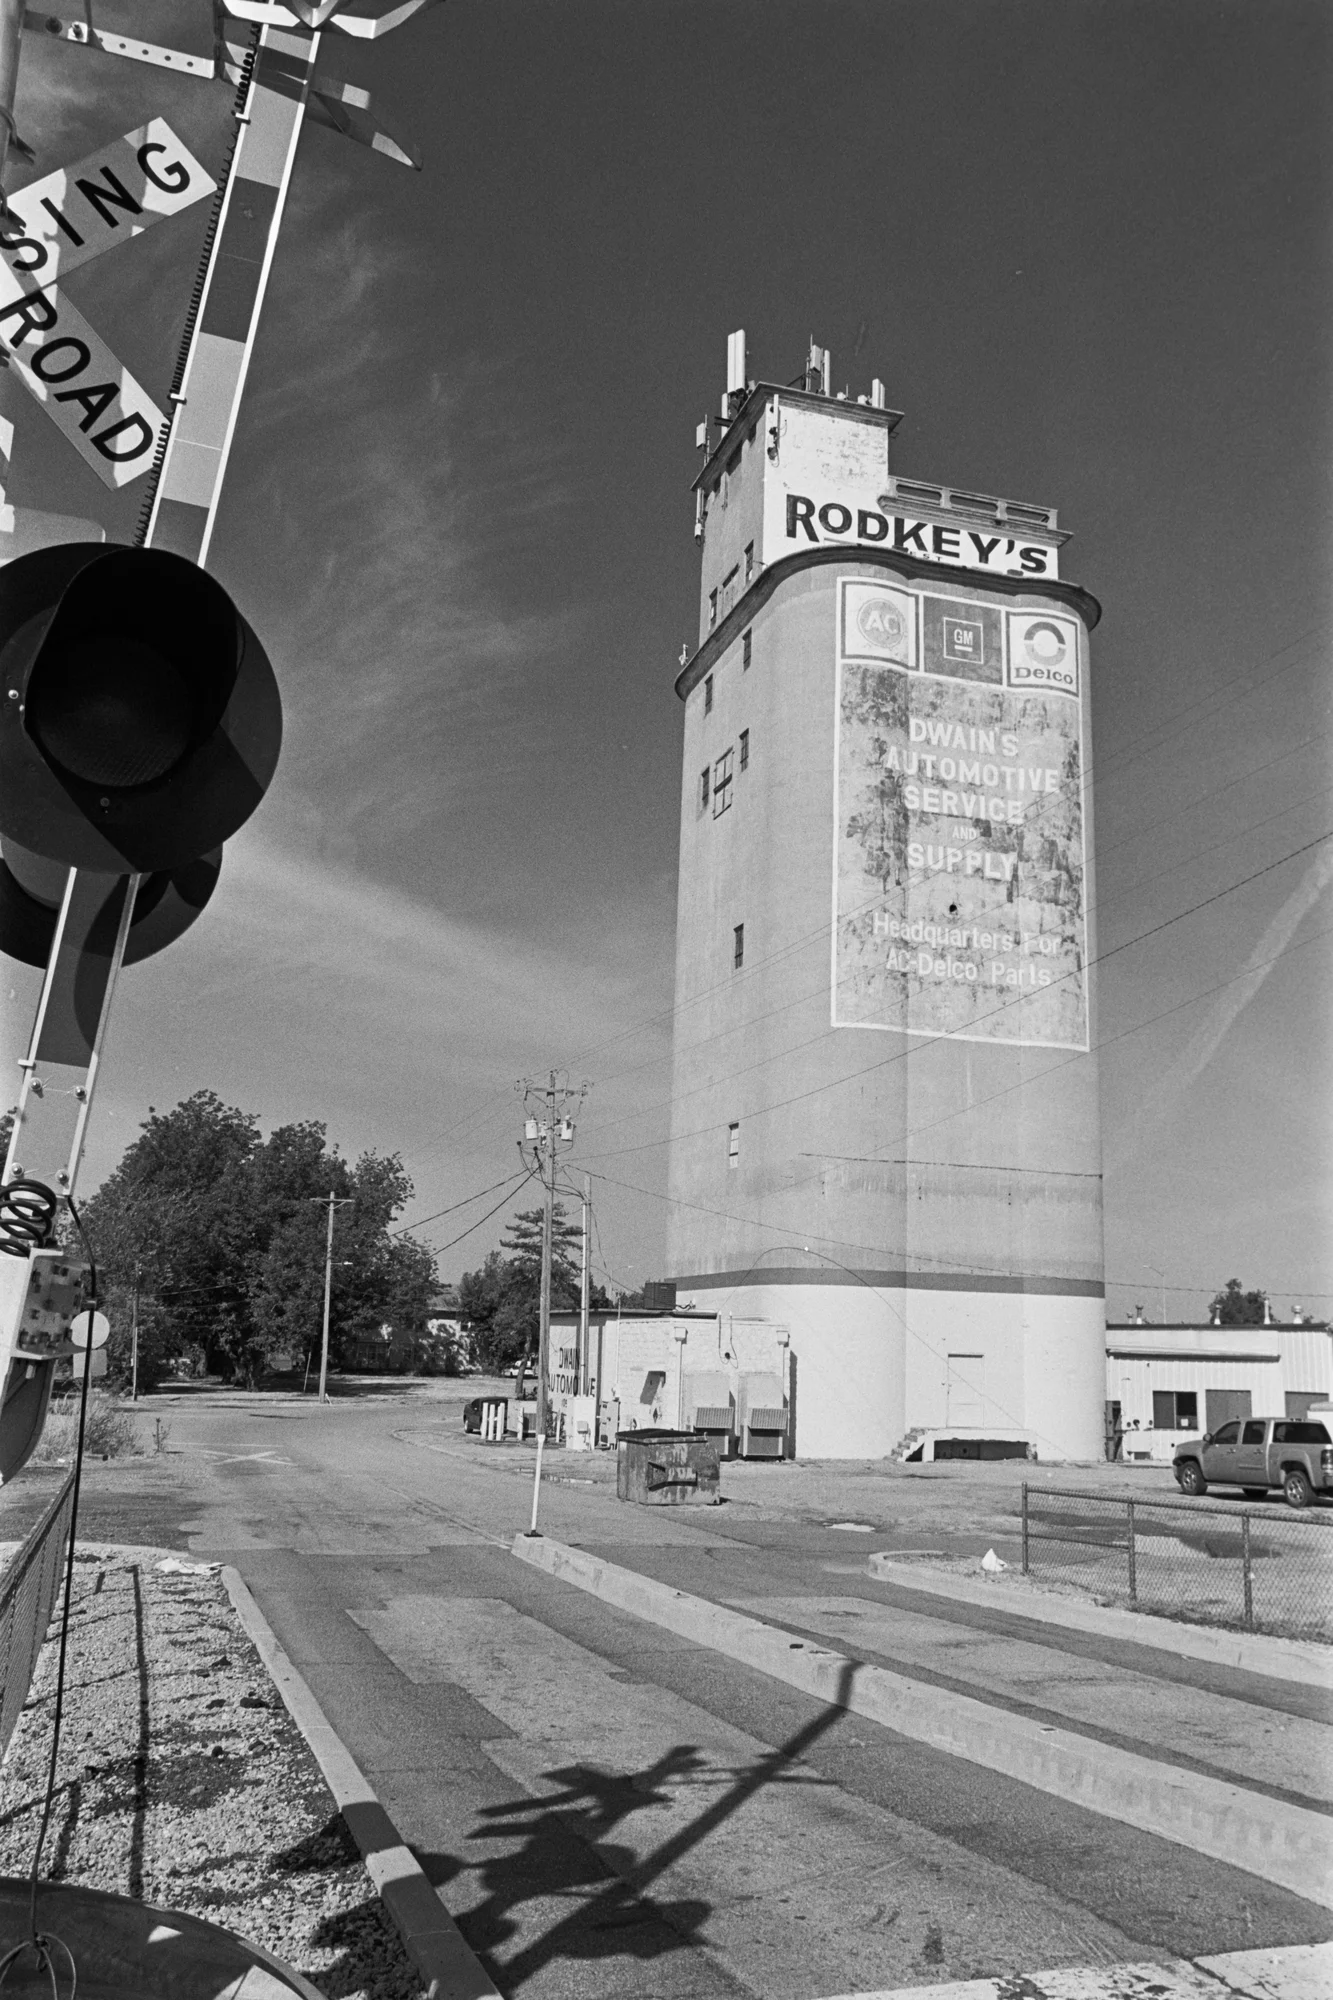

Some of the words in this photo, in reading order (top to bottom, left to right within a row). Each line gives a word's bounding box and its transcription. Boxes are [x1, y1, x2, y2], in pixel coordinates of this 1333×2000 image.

[786, 493, 1049, 574] RODKEY'S
[865, 610, 899, 635] AC
[953, 628, 974, 646] GM
[1014, 666, 1075, 685] Delco
[909, 717, 1019, 757] DWAIN'S
[886, 745, 1061, 794] AUTOMOTIVE
[904, 785, 1025, 825] SERVICE
[952, 825, 977, 840] AND
[907, 842, 1018, 882] SUPPLY
[873, 911, 1013, 951] Headquarters
[1023, 932, 1062, 955] For
